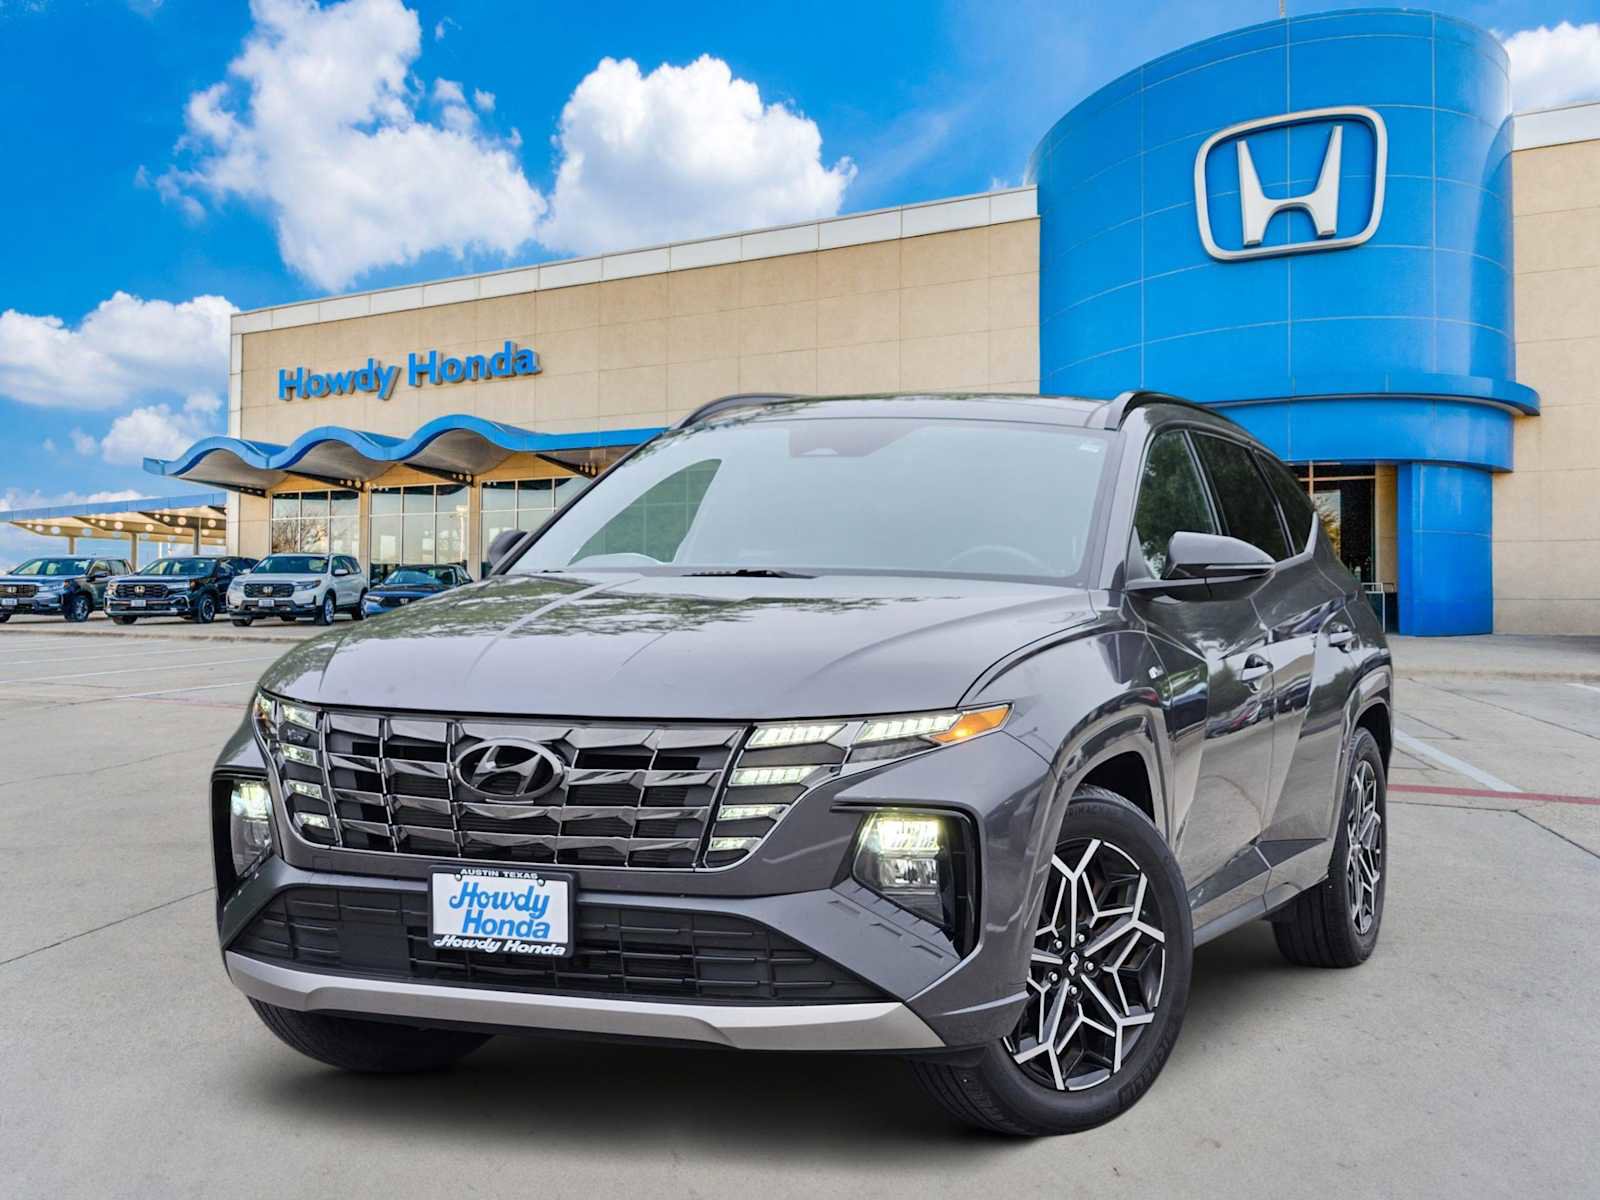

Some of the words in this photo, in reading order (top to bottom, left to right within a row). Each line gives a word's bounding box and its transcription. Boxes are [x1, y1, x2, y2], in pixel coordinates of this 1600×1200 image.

[278, 358, 400, 401] Howdy
[407, 341, 542, 388] Honda
[460, 868, 499, 877] AUSTIN
[503, 871, 538, 879] TEXAS
[449, 881, 551, 919] Howdy
[461, 909, 551, 939] Honda
[433, 935, 502, 952] Howdy
[503, 940, 567, 956] Honda
